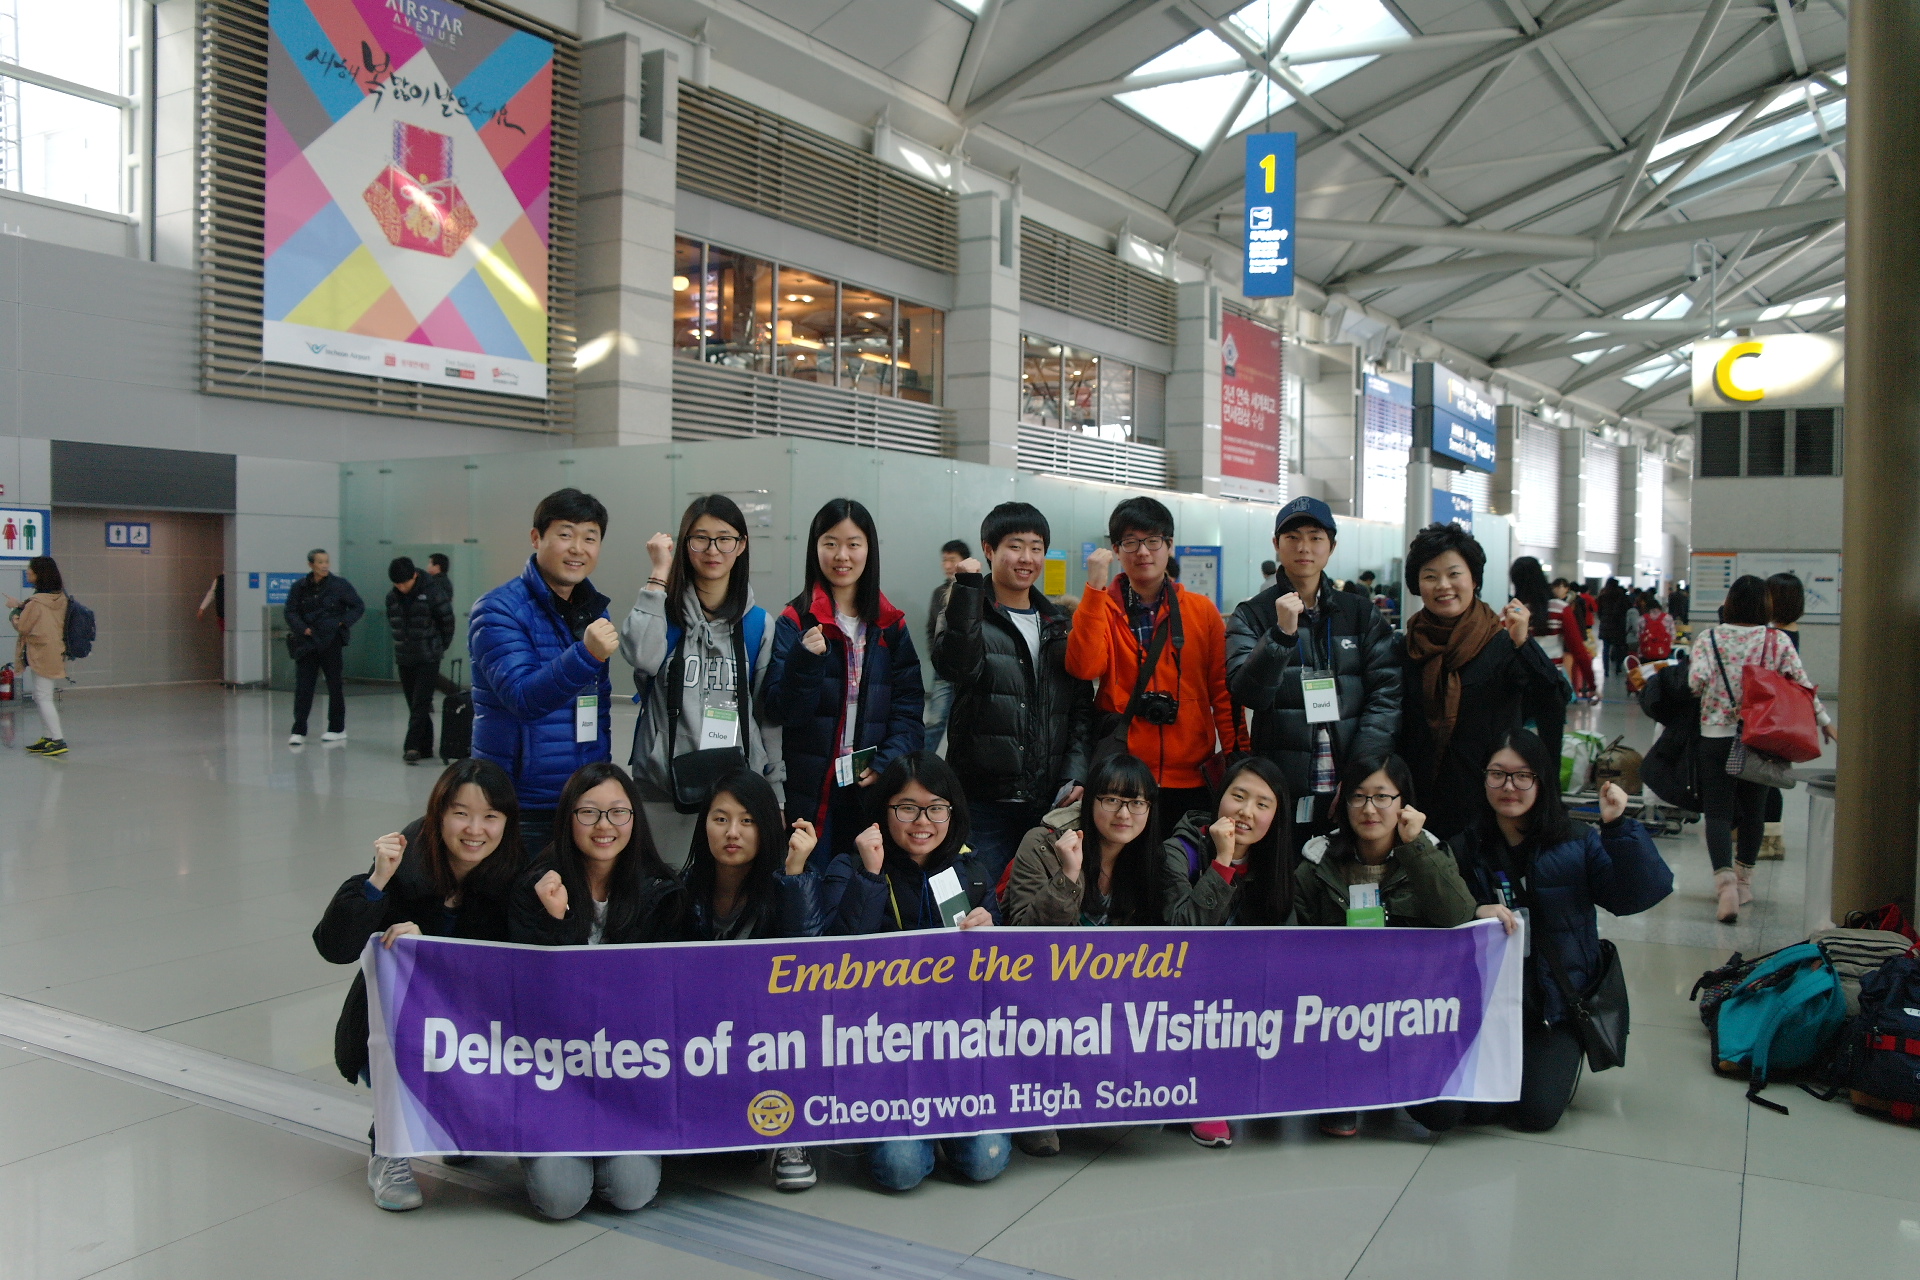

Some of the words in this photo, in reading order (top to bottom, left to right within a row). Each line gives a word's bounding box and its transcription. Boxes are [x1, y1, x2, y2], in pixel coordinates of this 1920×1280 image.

[385, 0, 464, 36] AIRSTAR
[393, 12, 457, 45] AVENUE
[1259, 154, 1276, 193] 1
[1716, 342, 1765, 402] C
[1312, 701, 1331, 709] David
[708, 731, 728, 740] Chloe
[768, 952, 955, 994] Embrace
[967, 945, 1034, 983] the
[1050, 941, 1189, 982] World!
[423, 1017, 671, 1091] Delegates
[684, 1020, 734, 1076] of
[747, 1028, 806, 1072] an
[822, 1002, 1112, 1067] International
[1123, 999, 1283, 1060] Visiting
[1293, 995, 1461, 1053] Program
[803, 1092, 997, 1127] Cheongwon
[1009, 1082, 1082, 1118] High
[1095, 1077, 1198, 1109] School
